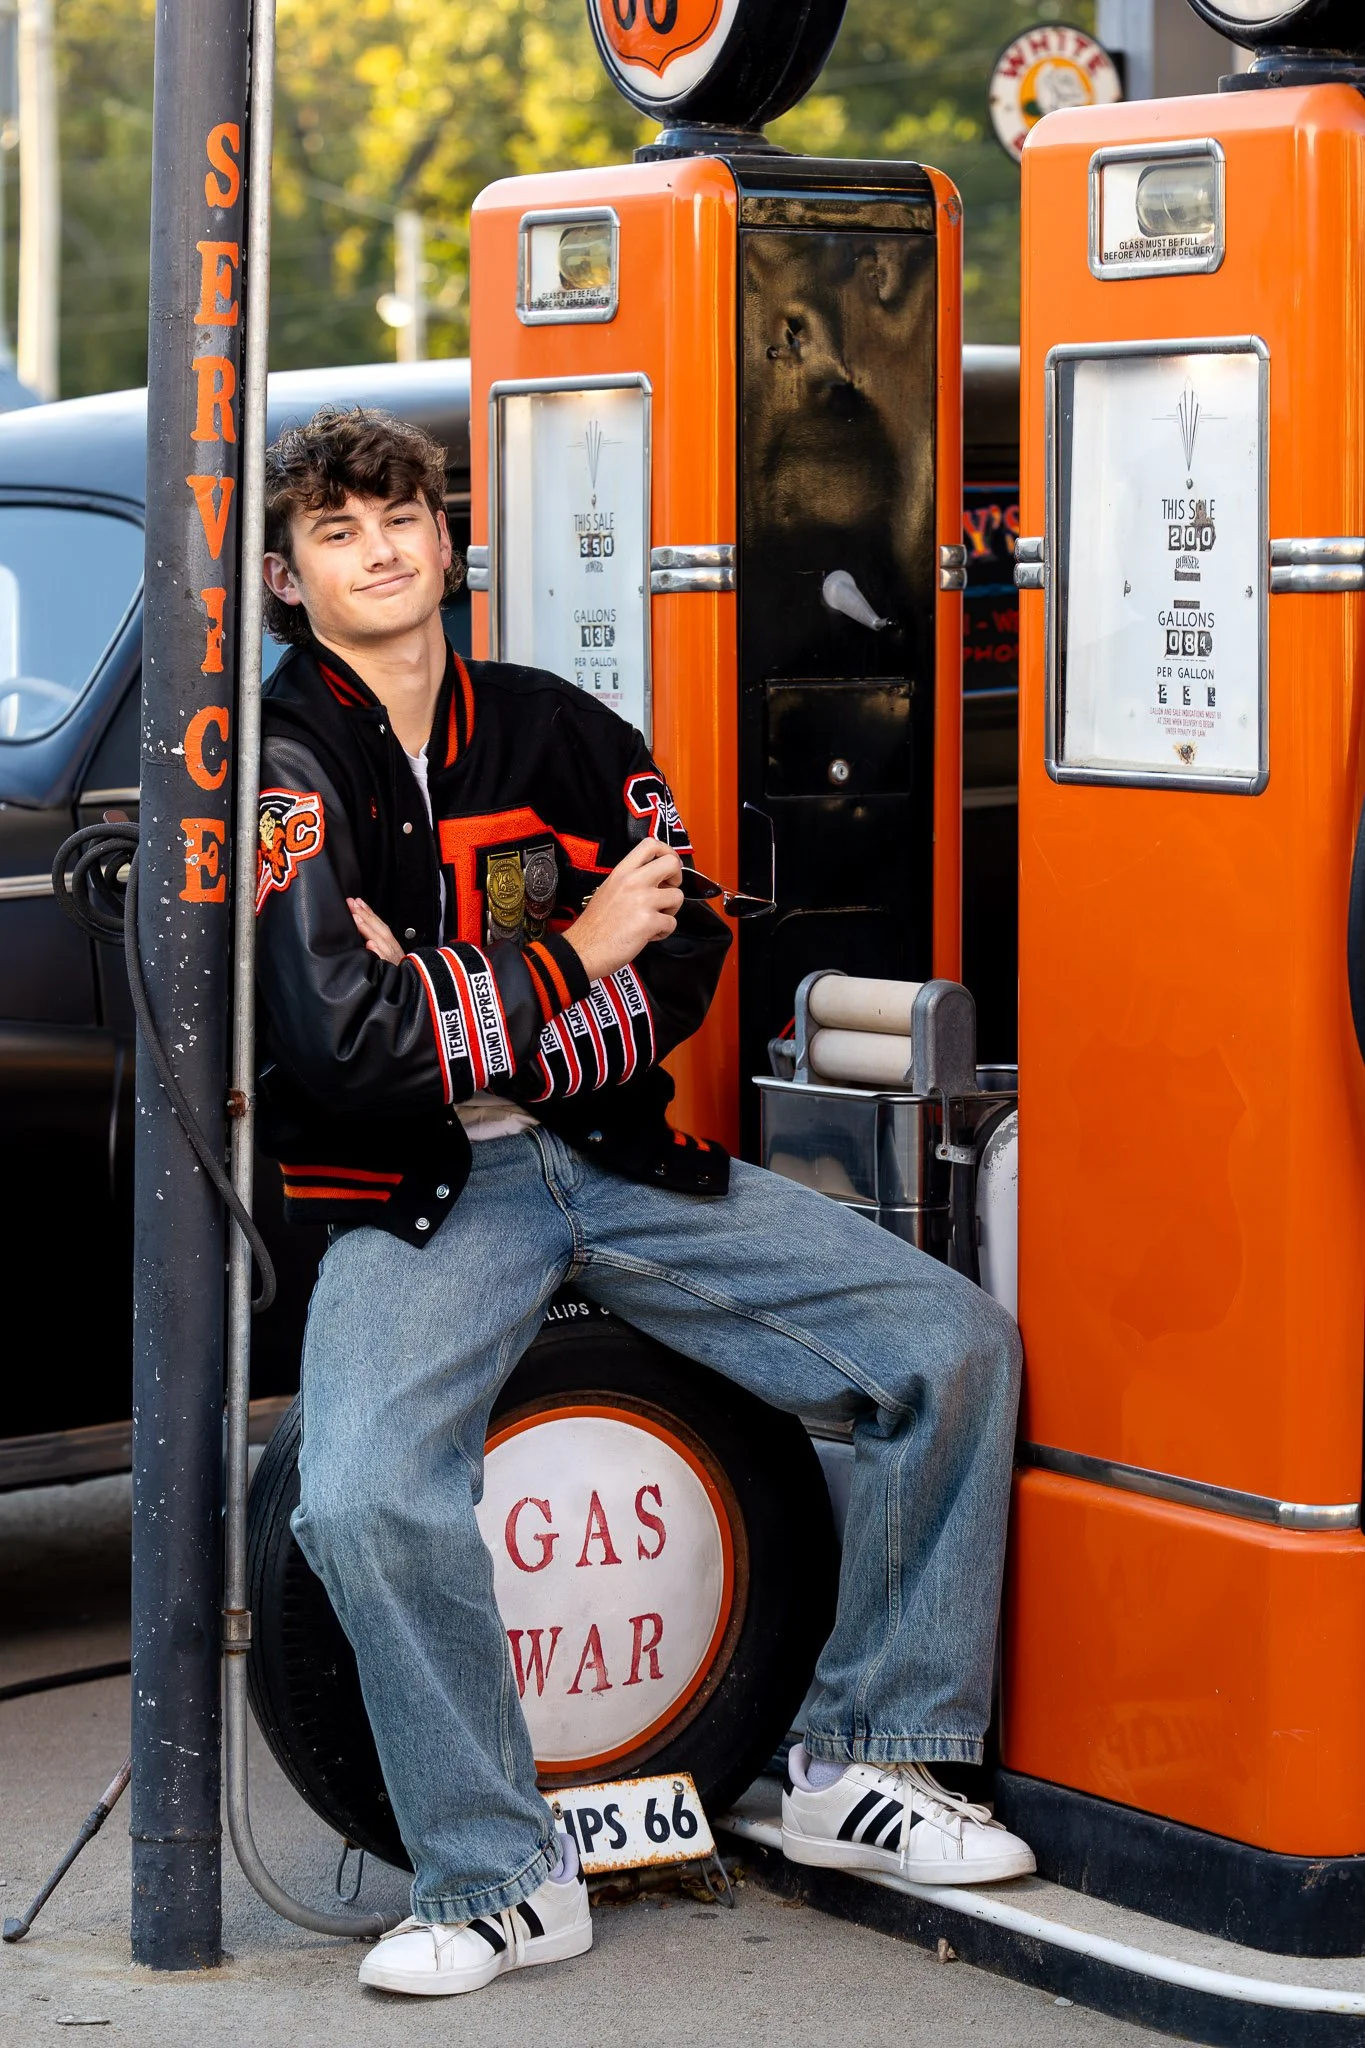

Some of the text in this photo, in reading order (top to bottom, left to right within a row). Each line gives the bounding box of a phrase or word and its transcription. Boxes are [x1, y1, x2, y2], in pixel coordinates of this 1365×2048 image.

[998, 32, 1109, 78] WHITE
[1104, 245, 1216, 260] BEFORE AND AFTER DELIVERY
[1119, 236, 1199, 250] GLASS MUST BE FULL
[542, 289, 601, 300] GLASS MUST BE FULL
[179, 122, 241, 904] SERVICE
[1161, 498, 1185, 520] THIS
[573, 511, 615, 532] THIS SALE
[573, 608, 617, 623] GALLONS
[1158, 610, 1215, 628] GALLONS
[574, 657, 617, 667] PER GALLON
[1156, 666, 1215, 680] PER GALLON
[286, 811, 317, 853] C
[617, 968, 642, 1013] SENIOR
[446, 1011, 465, 1057] TENNIS
[473, 974, 505, 1073] SOUND EXPRESS
[543, 1303, 590, 1321] LLIPS
[504, 1483, 667, 1573] GAS
[506, 1612, 665, 1700] WAR
[644, 1793, 698, 1844] 66
